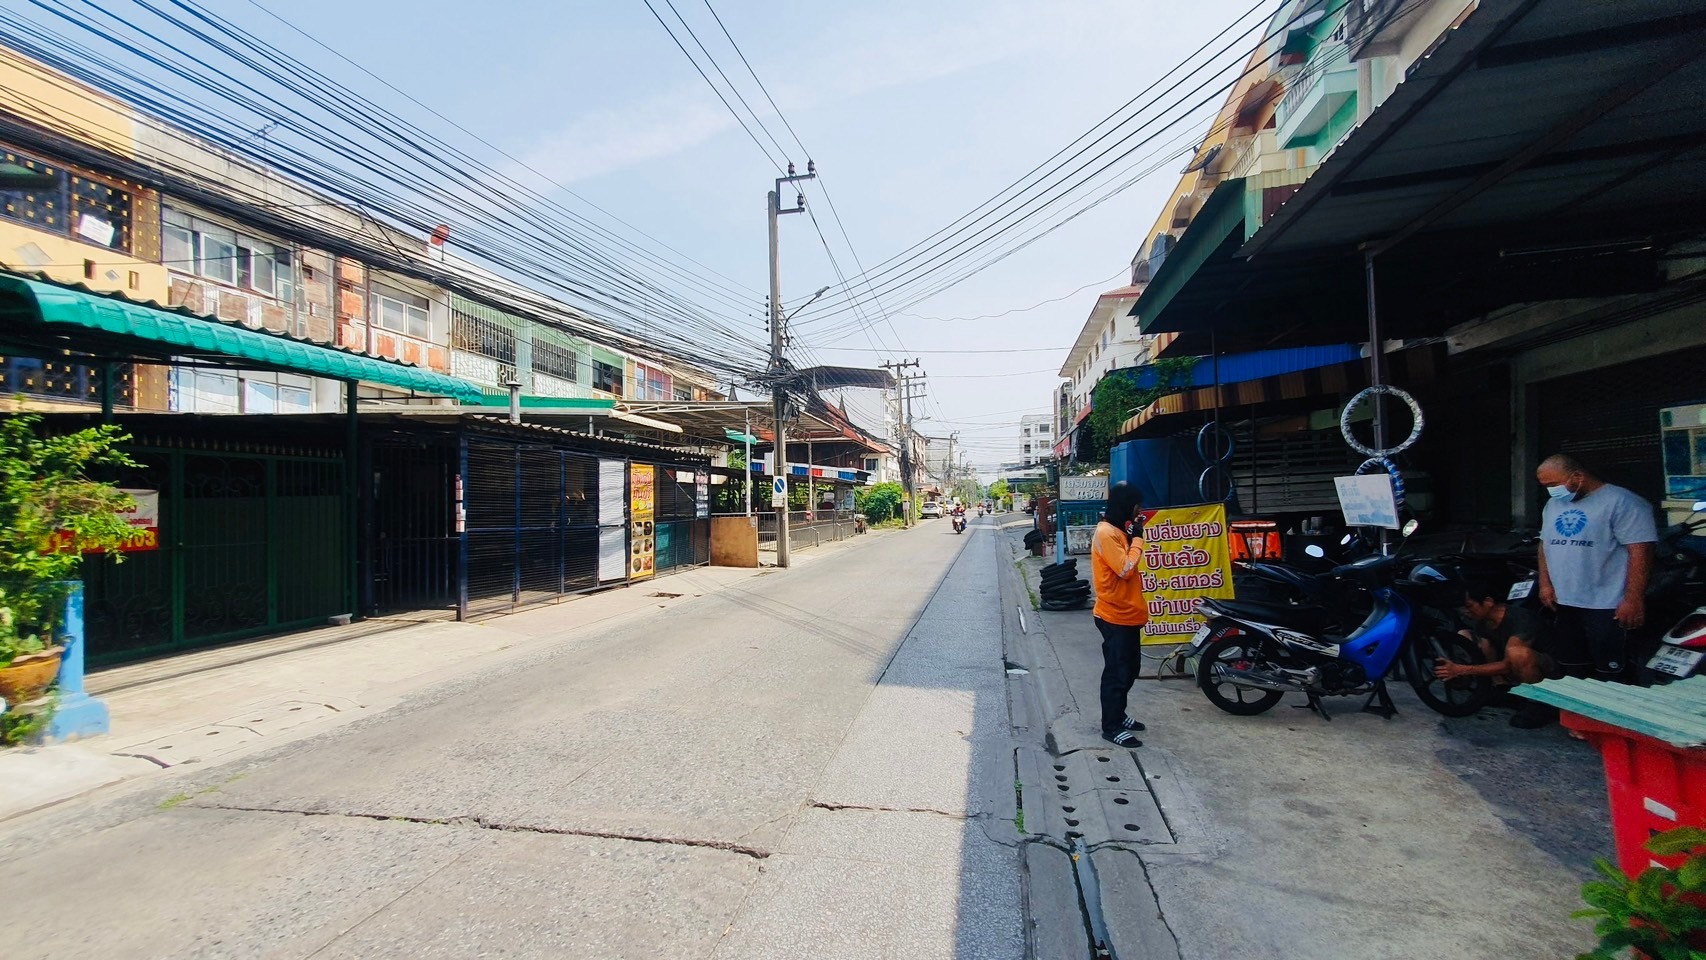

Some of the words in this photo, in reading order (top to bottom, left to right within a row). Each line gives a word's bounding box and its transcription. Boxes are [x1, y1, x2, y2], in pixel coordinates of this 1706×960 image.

[1145, 519, 1222, 542] เปลี่ยนยาง
[1570, 539, 1594, 547] TIRE
[1144, 545, 1210, 570] ขึ้นล้อ
[1170, 570, 1223, 590] สเตอร์
[1148, 596, 1205, 616] ผ้าเบร
[1144, 620, 1207, 636] น้ำมันเครื่อ
